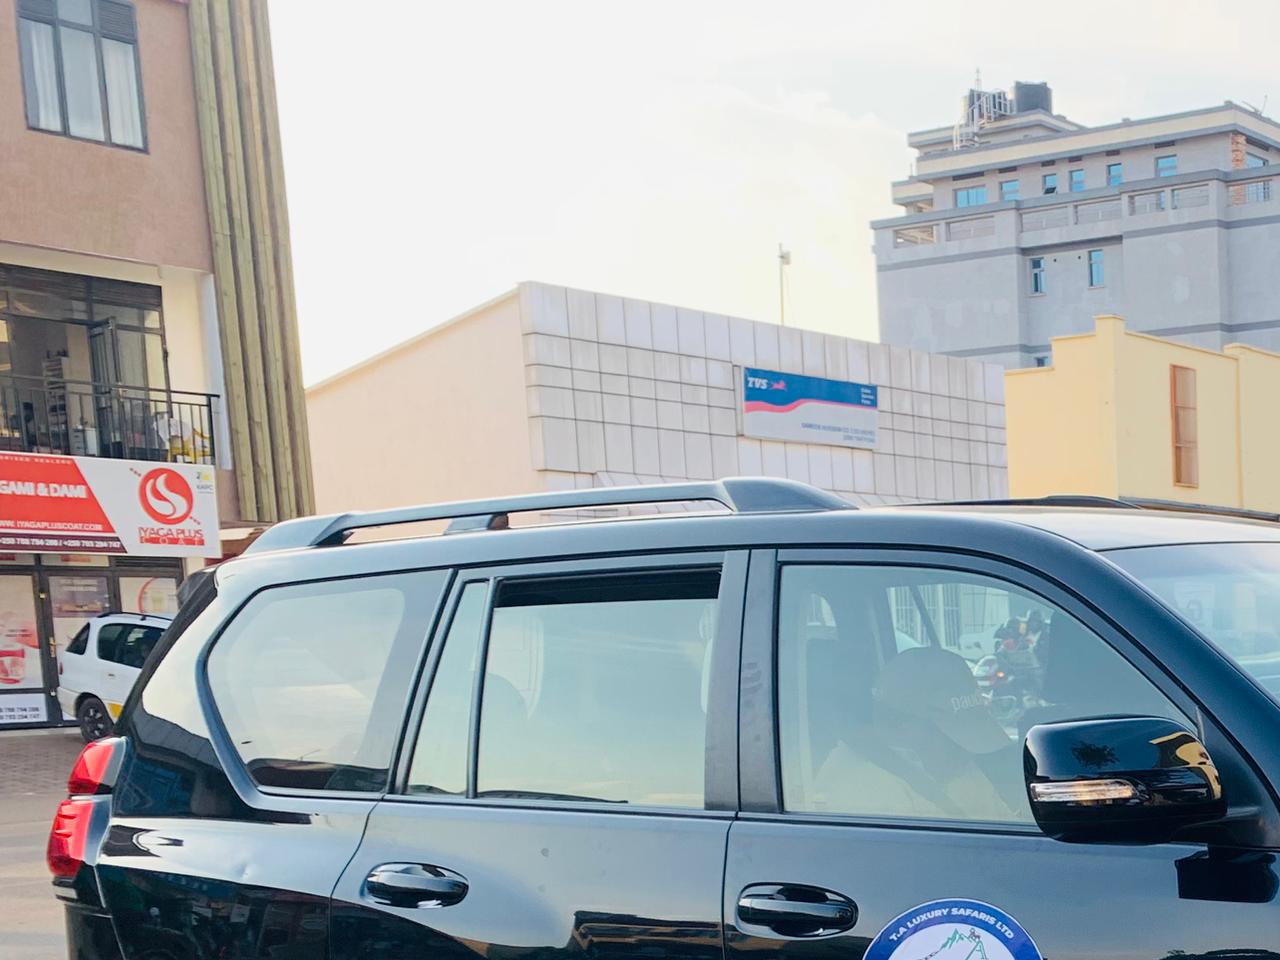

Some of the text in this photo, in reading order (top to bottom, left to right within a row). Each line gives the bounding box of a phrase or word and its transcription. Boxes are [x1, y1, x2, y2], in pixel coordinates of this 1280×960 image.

[747, 377, 769, 389] TVS
[889, 907, 1014, 941] T.A LUXURY SAFARIS LTD
